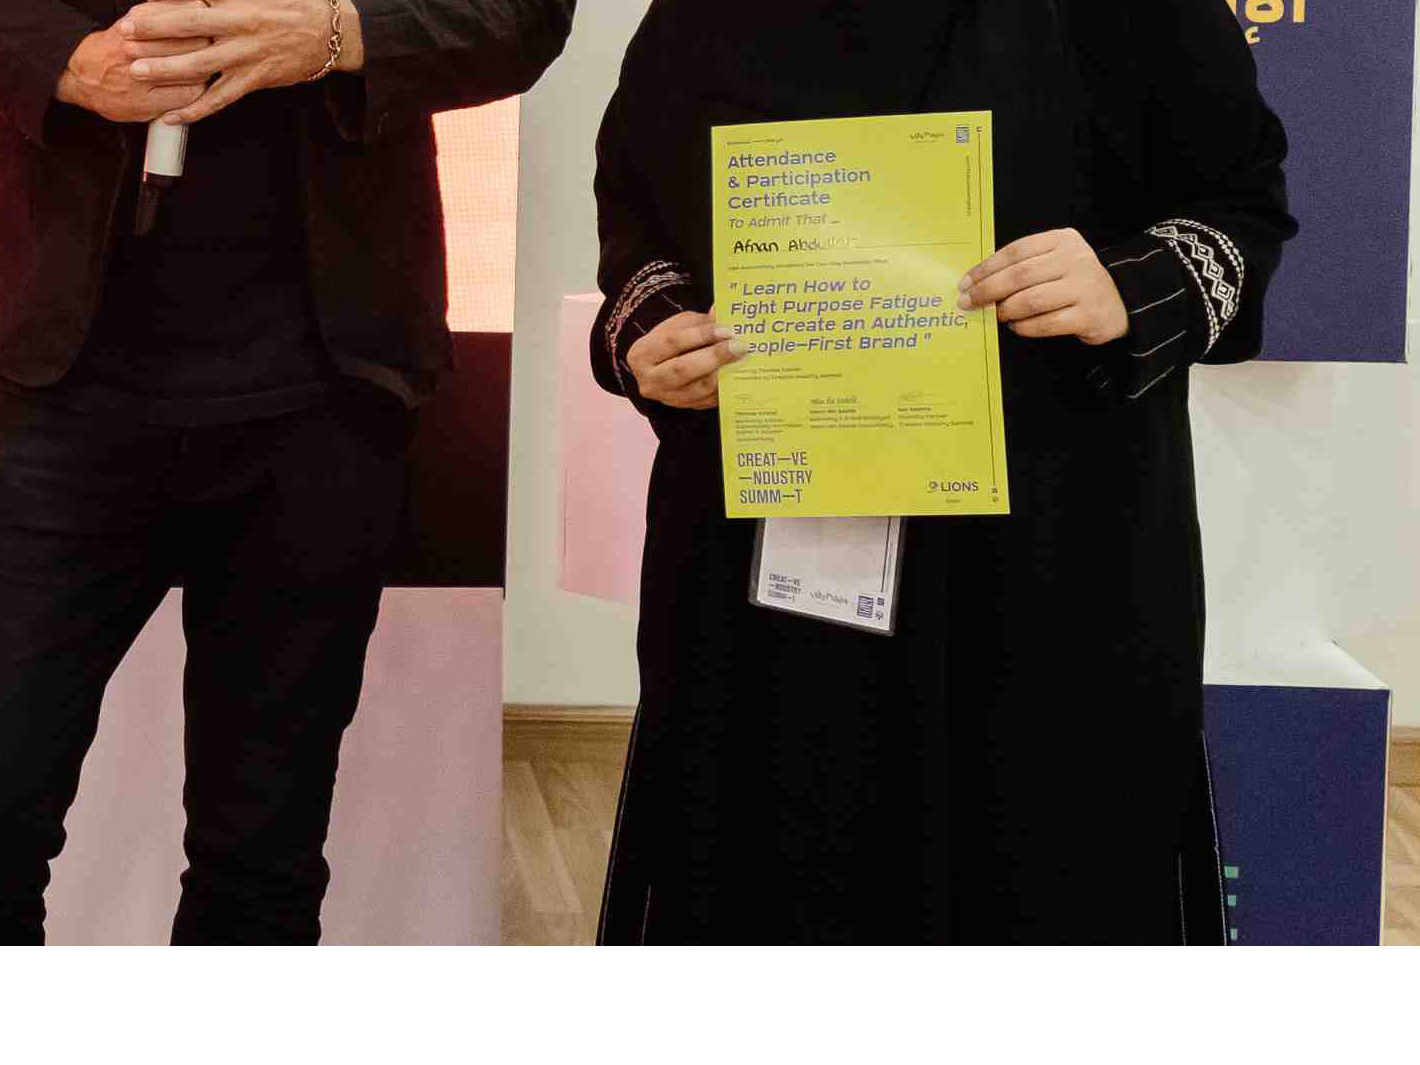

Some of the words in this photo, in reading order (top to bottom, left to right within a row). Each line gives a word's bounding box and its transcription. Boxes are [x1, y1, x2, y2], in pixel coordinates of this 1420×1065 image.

[727, 151, 837, 169] Attendance
[727, 175, 740, 189] &
[746, 168, 872, 188] Participation
[727, 191, 831, 210] Certificate
[729, 218, 744, 229] To
[748, 215, 790, 228] Admit
[796, 213, 828, 225] That
[733, 239, 779, 253] Afnan
[742, 282, 797, 296] Learn
[803, 278, 845, 294] How
[852, 277, 871, 291] to
[730, 300, 776, 319] Fight
[782, 298, 864, 316] Purpose
[869, 294, 942, 312] Fatigue
[733, 319, 766, 334] and
[771, 316, 836, 333] Create
[842, 317, 865, 331] an
[871, 312, 969, 330] Authentic,
[747, 336, 853, 356] eople-First
[859, 332, 917, 349] Brand
[941, 481, 979, 492] LIONS
